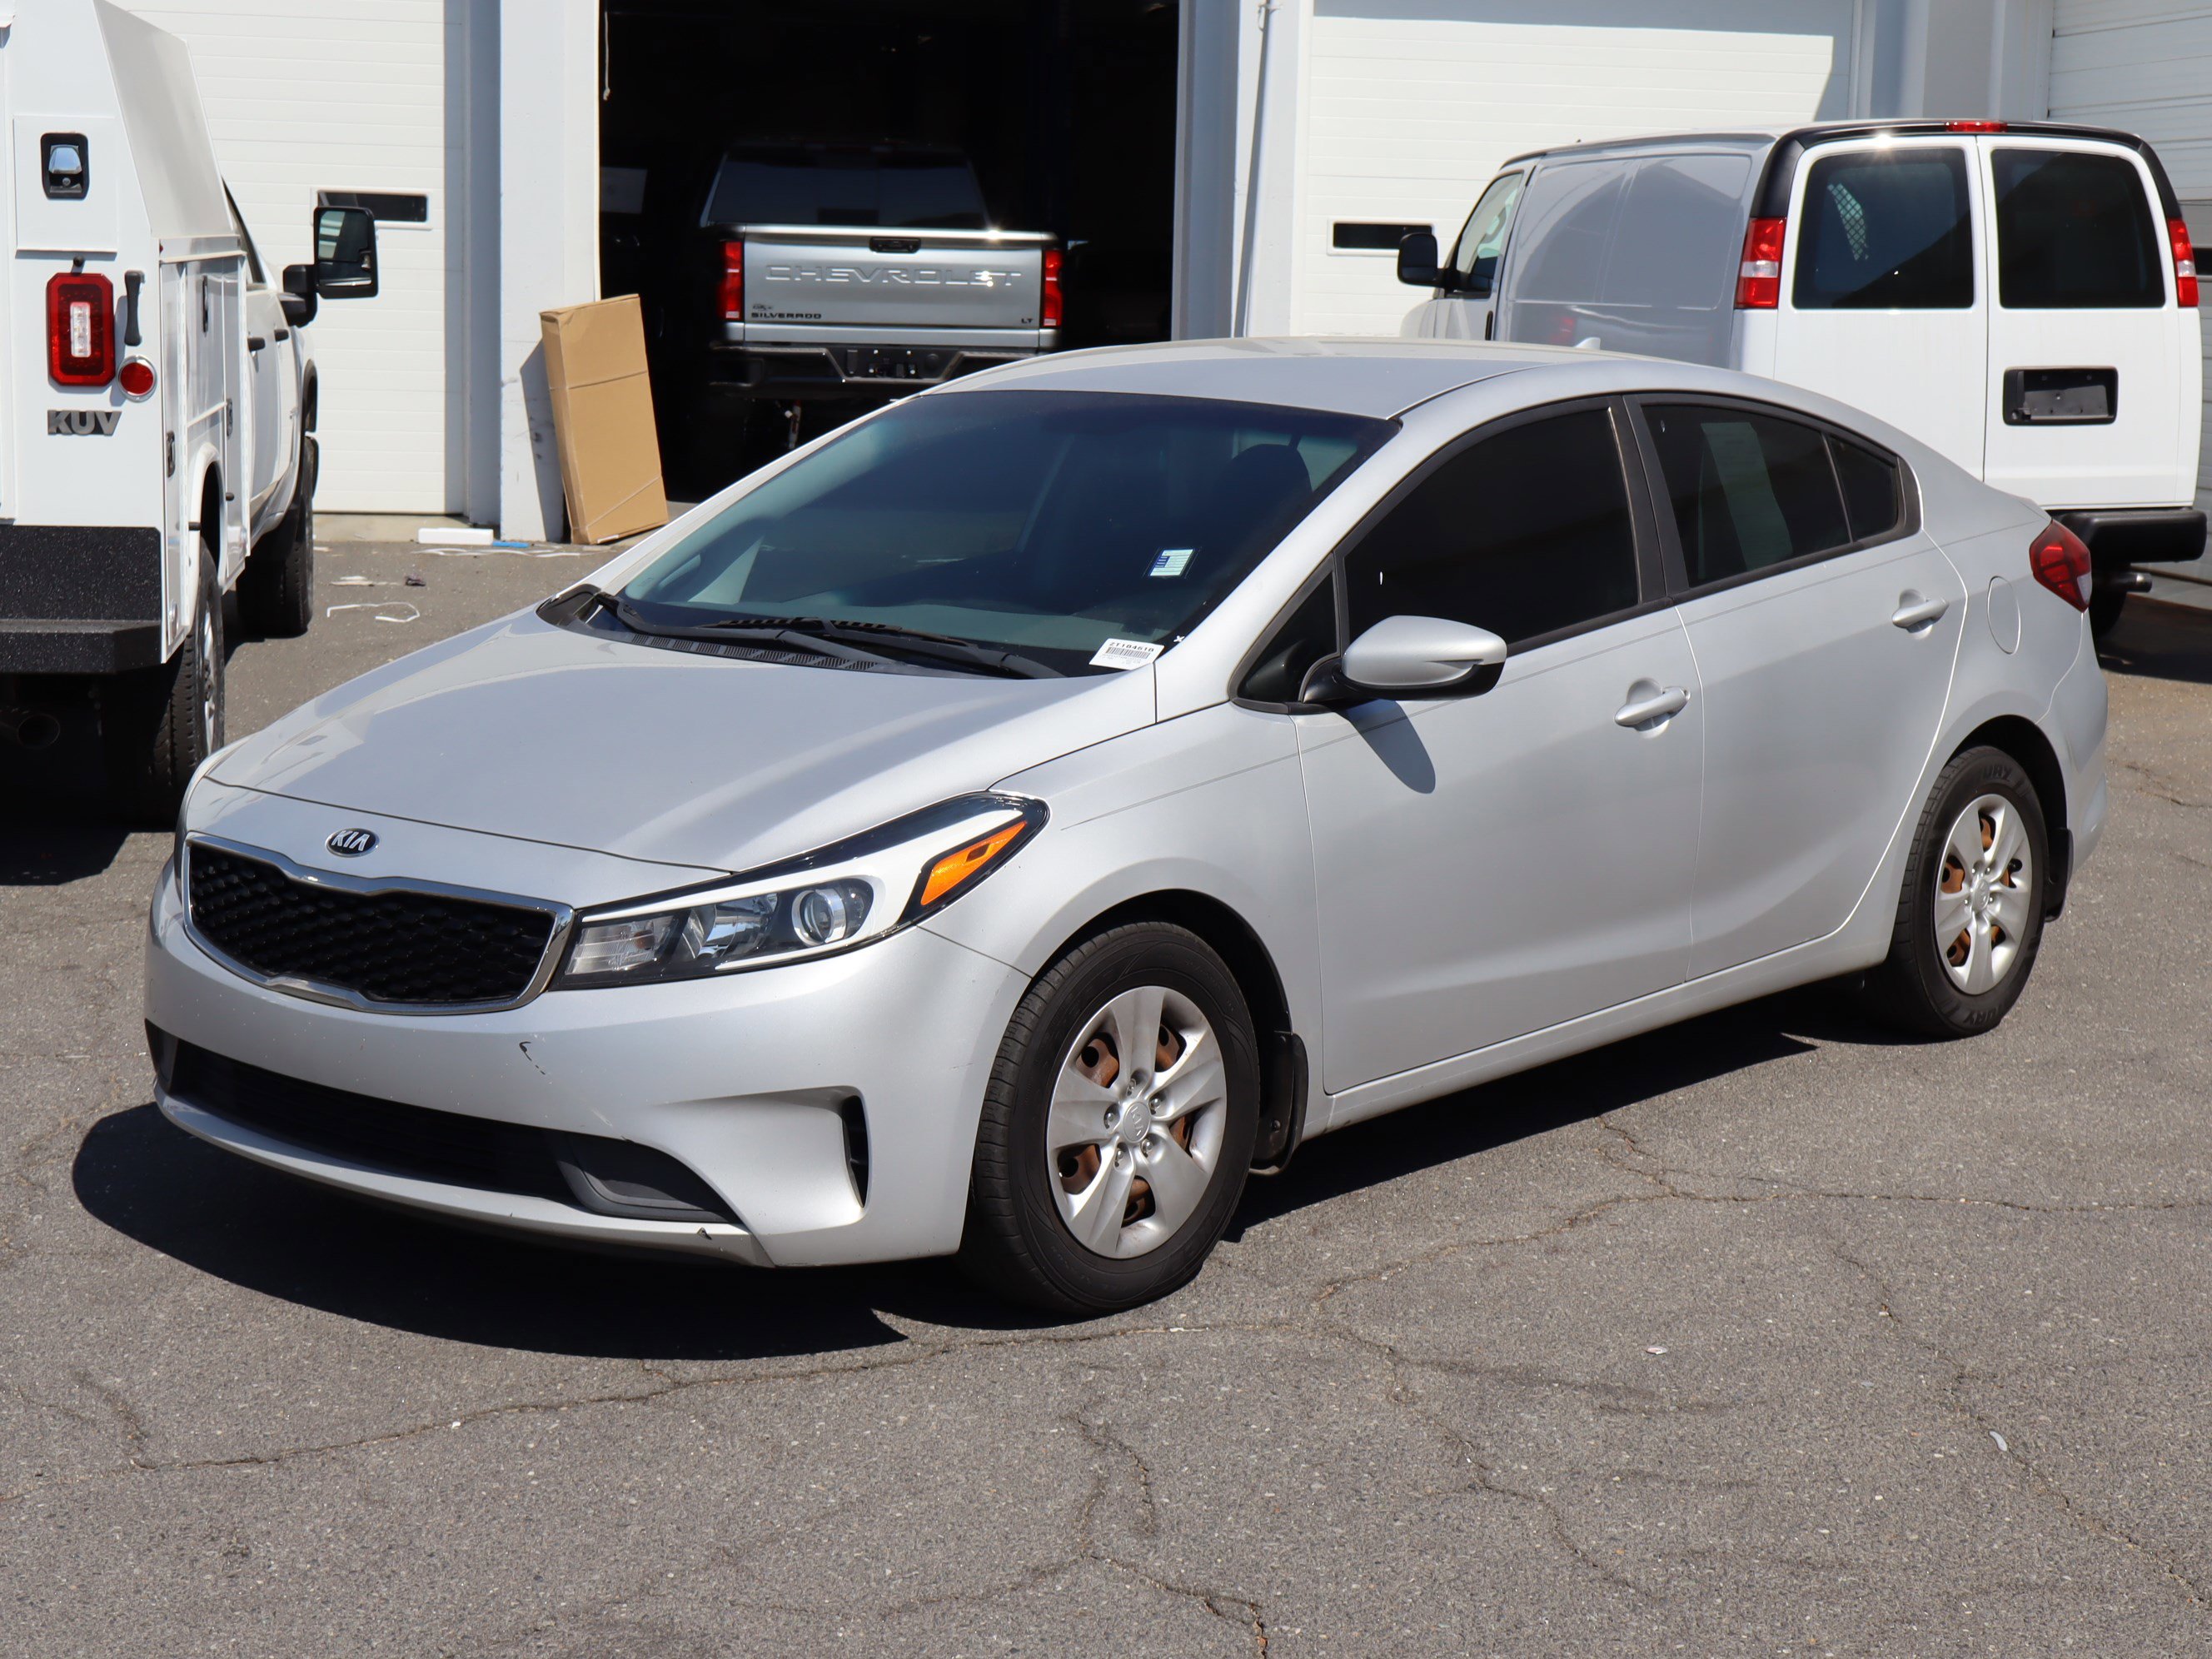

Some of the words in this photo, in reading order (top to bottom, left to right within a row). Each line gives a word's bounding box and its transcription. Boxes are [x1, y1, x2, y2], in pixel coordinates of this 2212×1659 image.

[765, 265, 1021, 286] CHEVROLET
[47, 410, 122, 436] KUV
[331, 830, 371, 851] KIA
